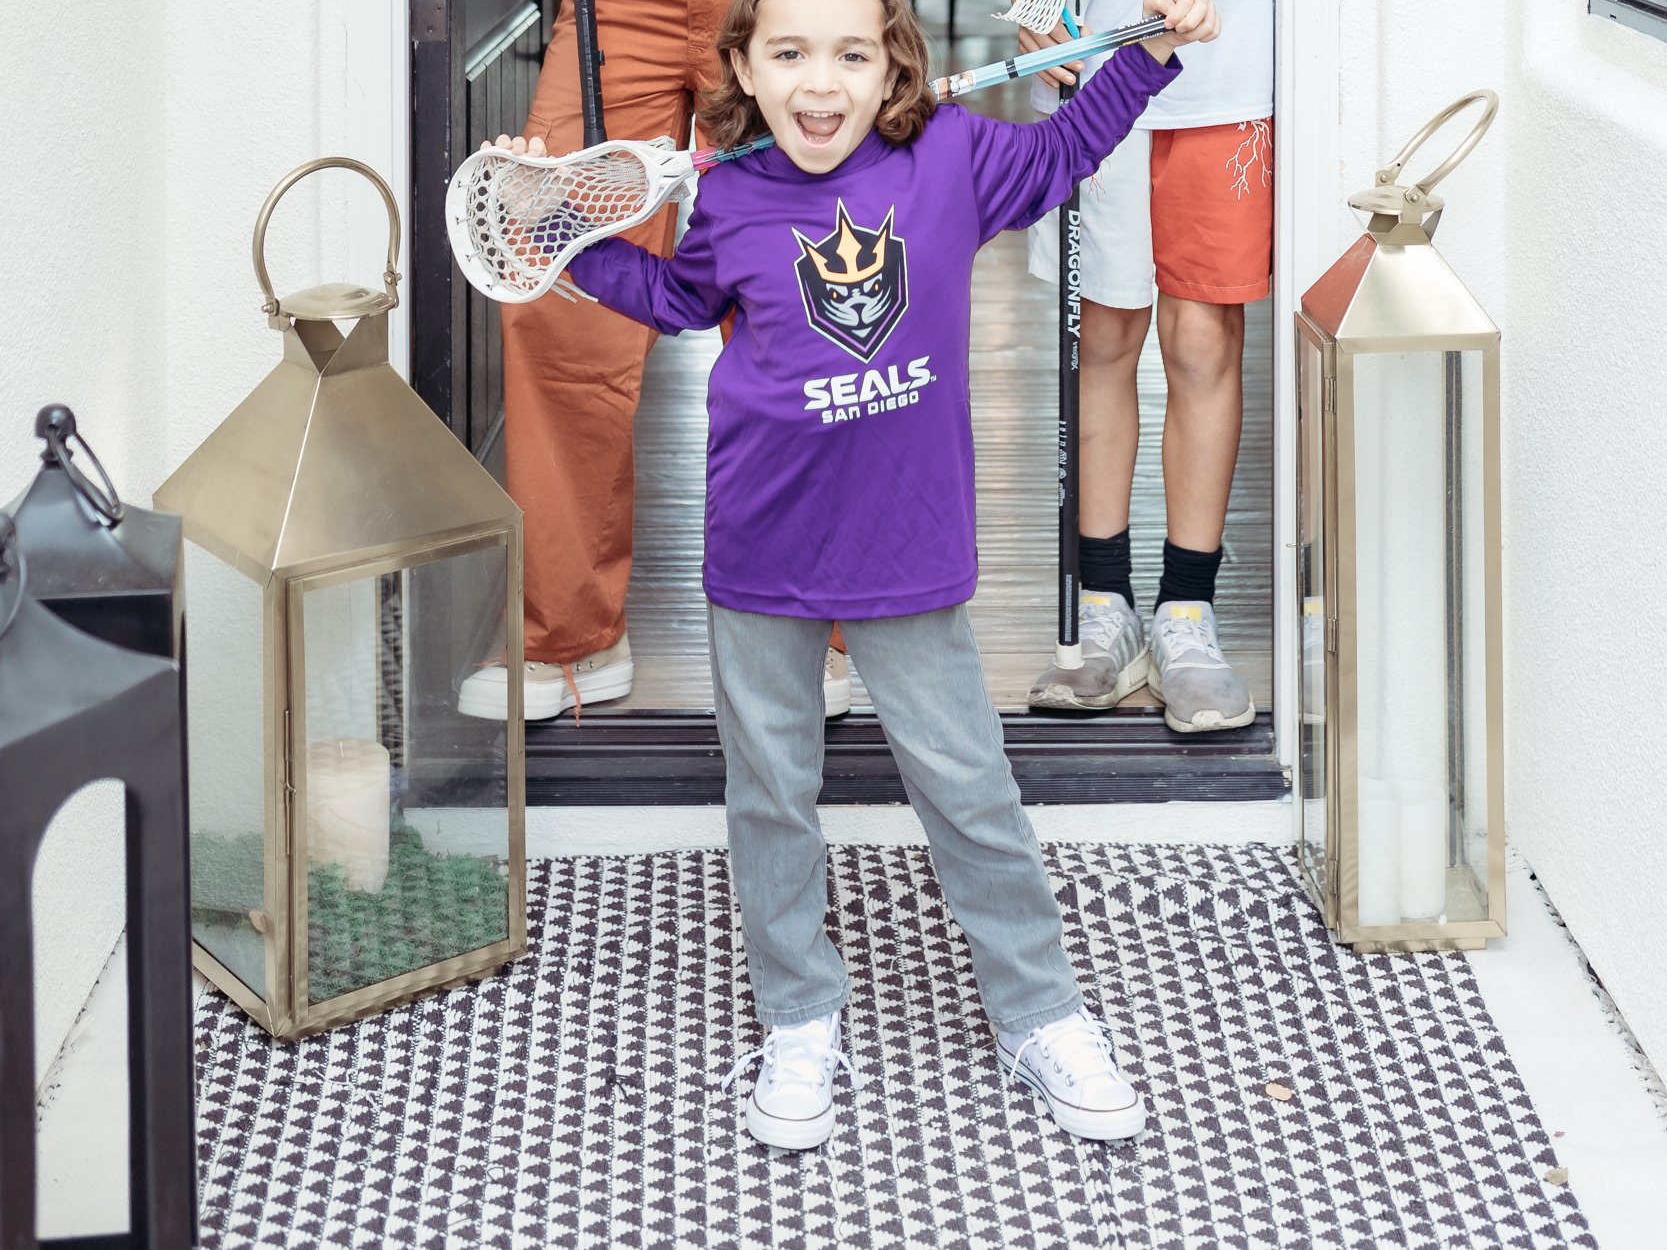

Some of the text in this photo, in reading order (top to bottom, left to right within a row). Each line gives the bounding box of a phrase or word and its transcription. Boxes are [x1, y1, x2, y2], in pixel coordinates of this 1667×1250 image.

[1068, 209, 1080, 339] DRAGONFLY
[803, 355, 931, 410] SEALS
[821, 390, 919, 424] SAN DIEGO
